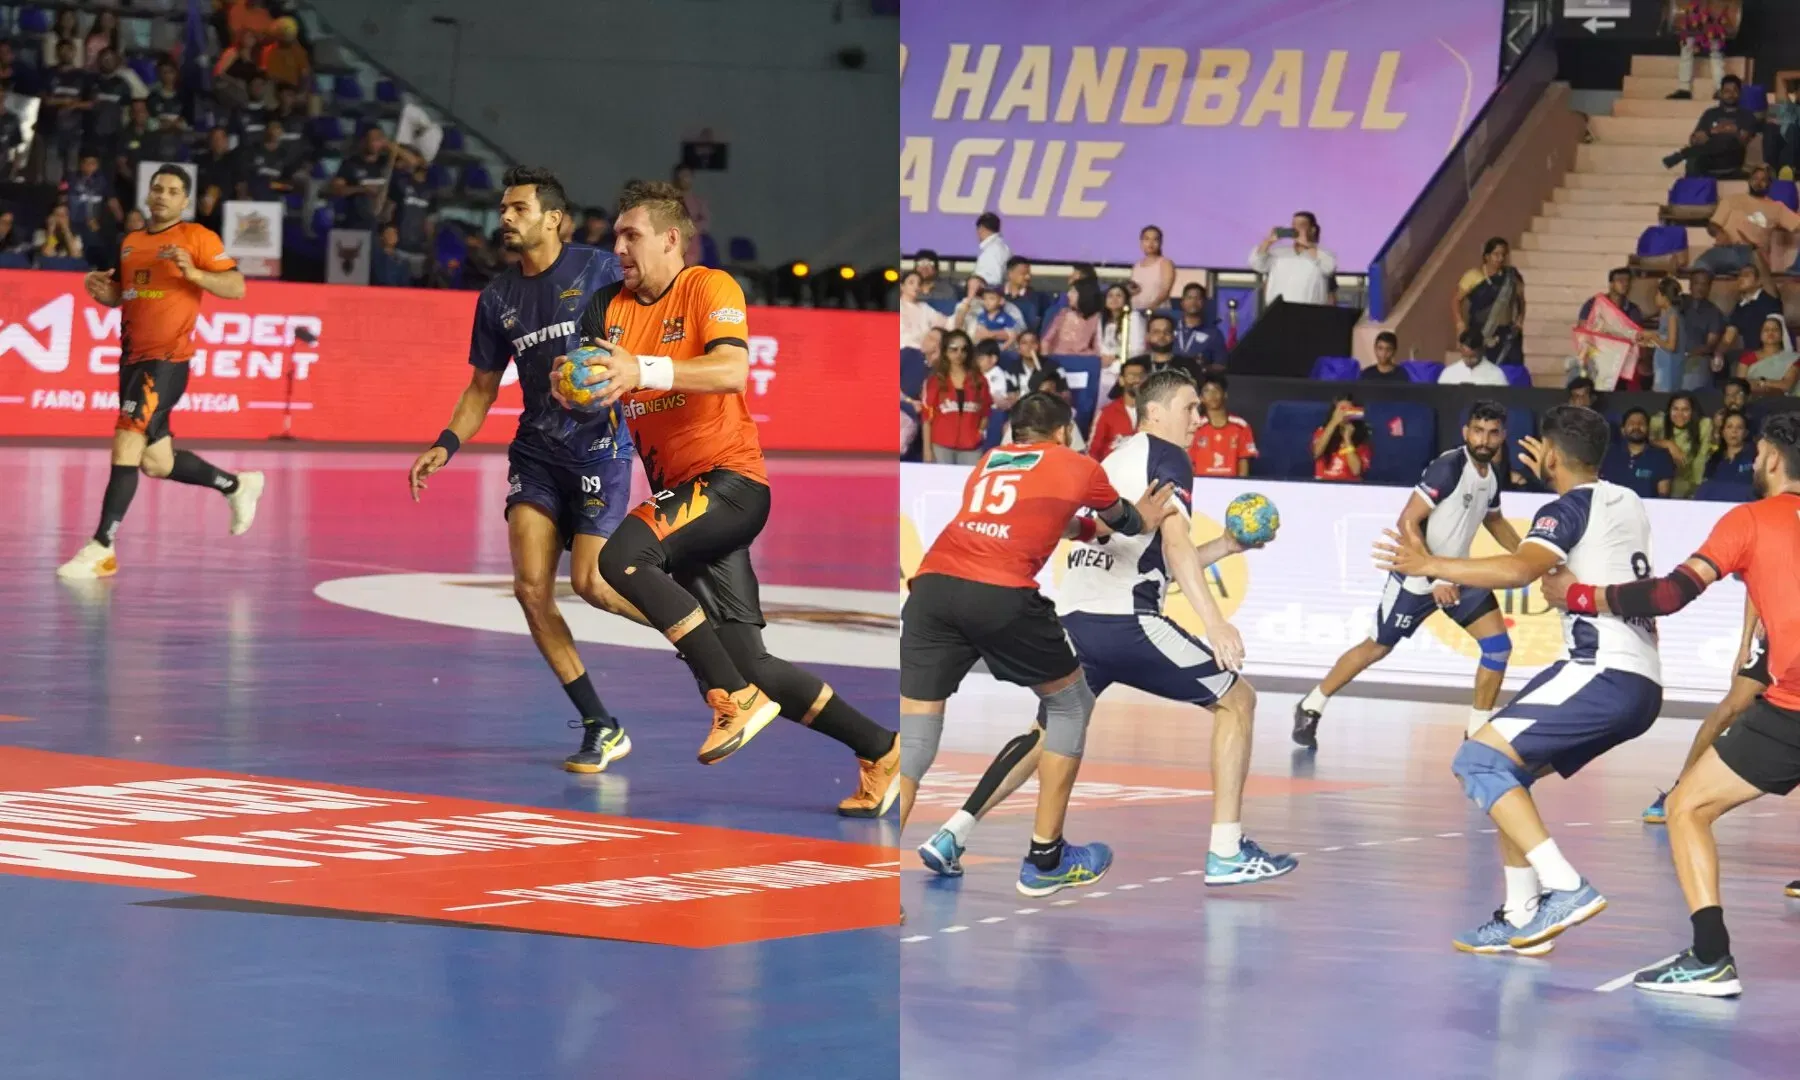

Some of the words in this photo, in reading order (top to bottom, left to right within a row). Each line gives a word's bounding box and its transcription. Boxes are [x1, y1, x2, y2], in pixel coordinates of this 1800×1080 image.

[932, 43, 1408, 129] HANDBALL
[900, 136, 1125, 217] AGUE
[83, 306, 322, 347] WNDER
[31, 389, 86, 412] FARQ
[581, 475, 601, 494] 09
[969, 474, 1022, 515] 15
[958, 521, 1012, 540] SHOK
[1394, 613, 1413, 629] 15
